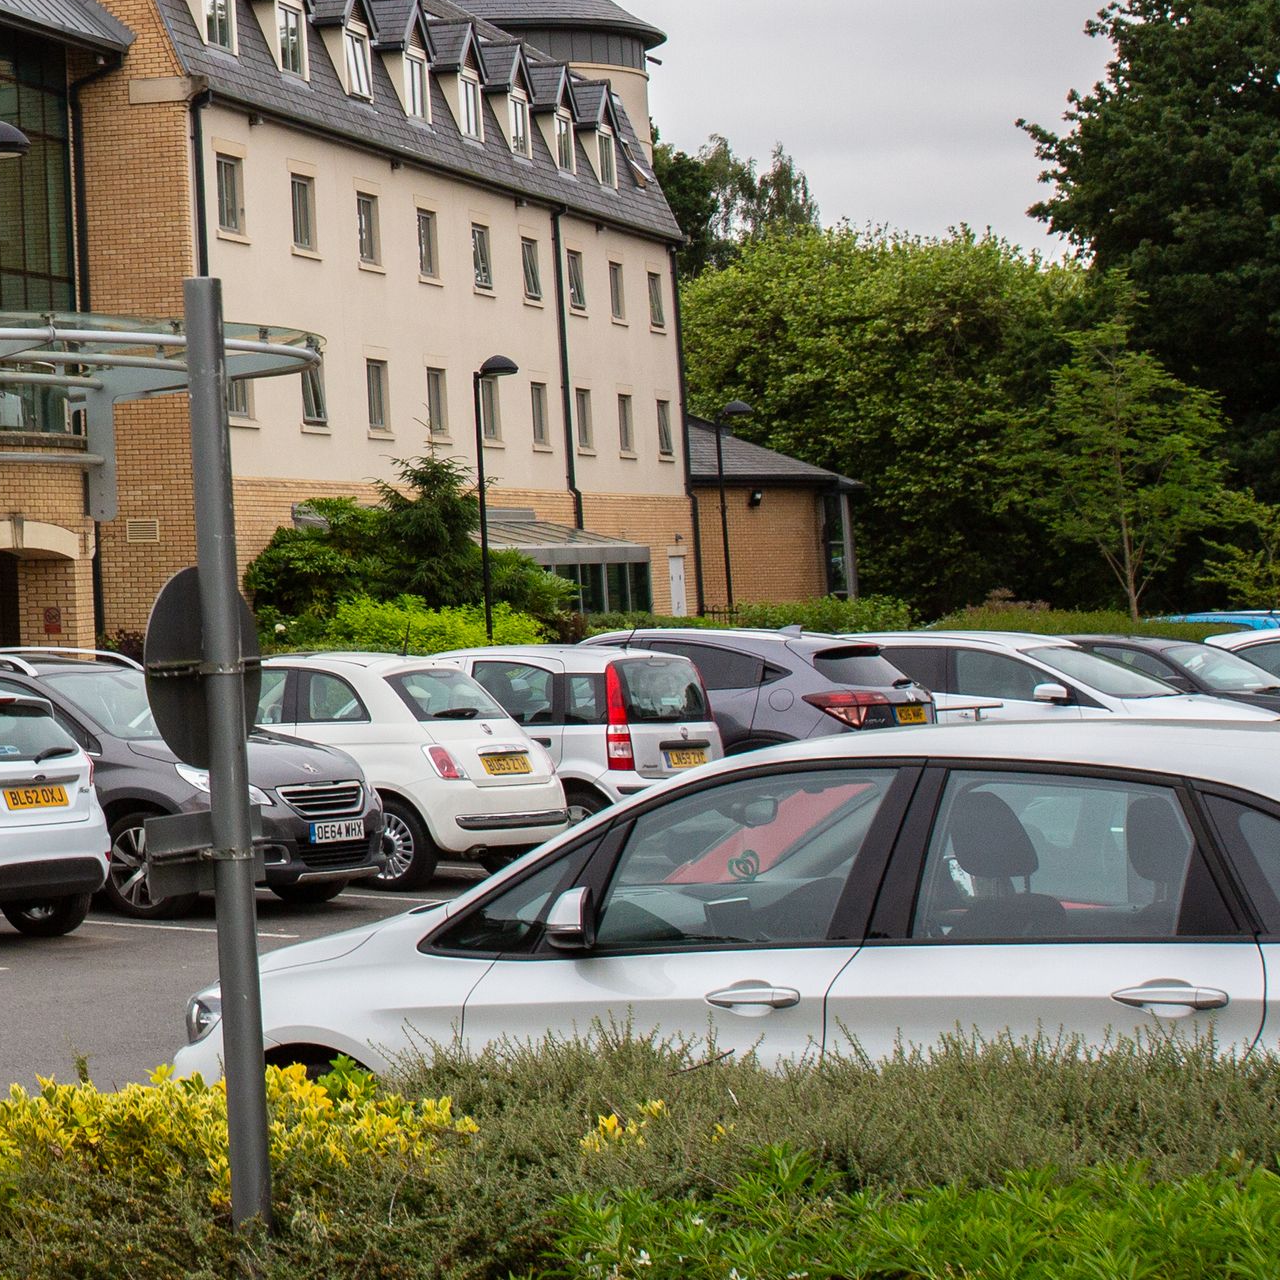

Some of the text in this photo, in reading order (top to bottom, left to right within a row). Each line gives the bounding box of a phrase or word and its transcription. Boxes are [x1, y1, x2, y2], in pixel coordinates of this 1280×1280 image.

[9, 790, 40, 806] BL62
[41, 787, 64, 803] OXJ
[317, 821, 363, 840] OE64 WHX
